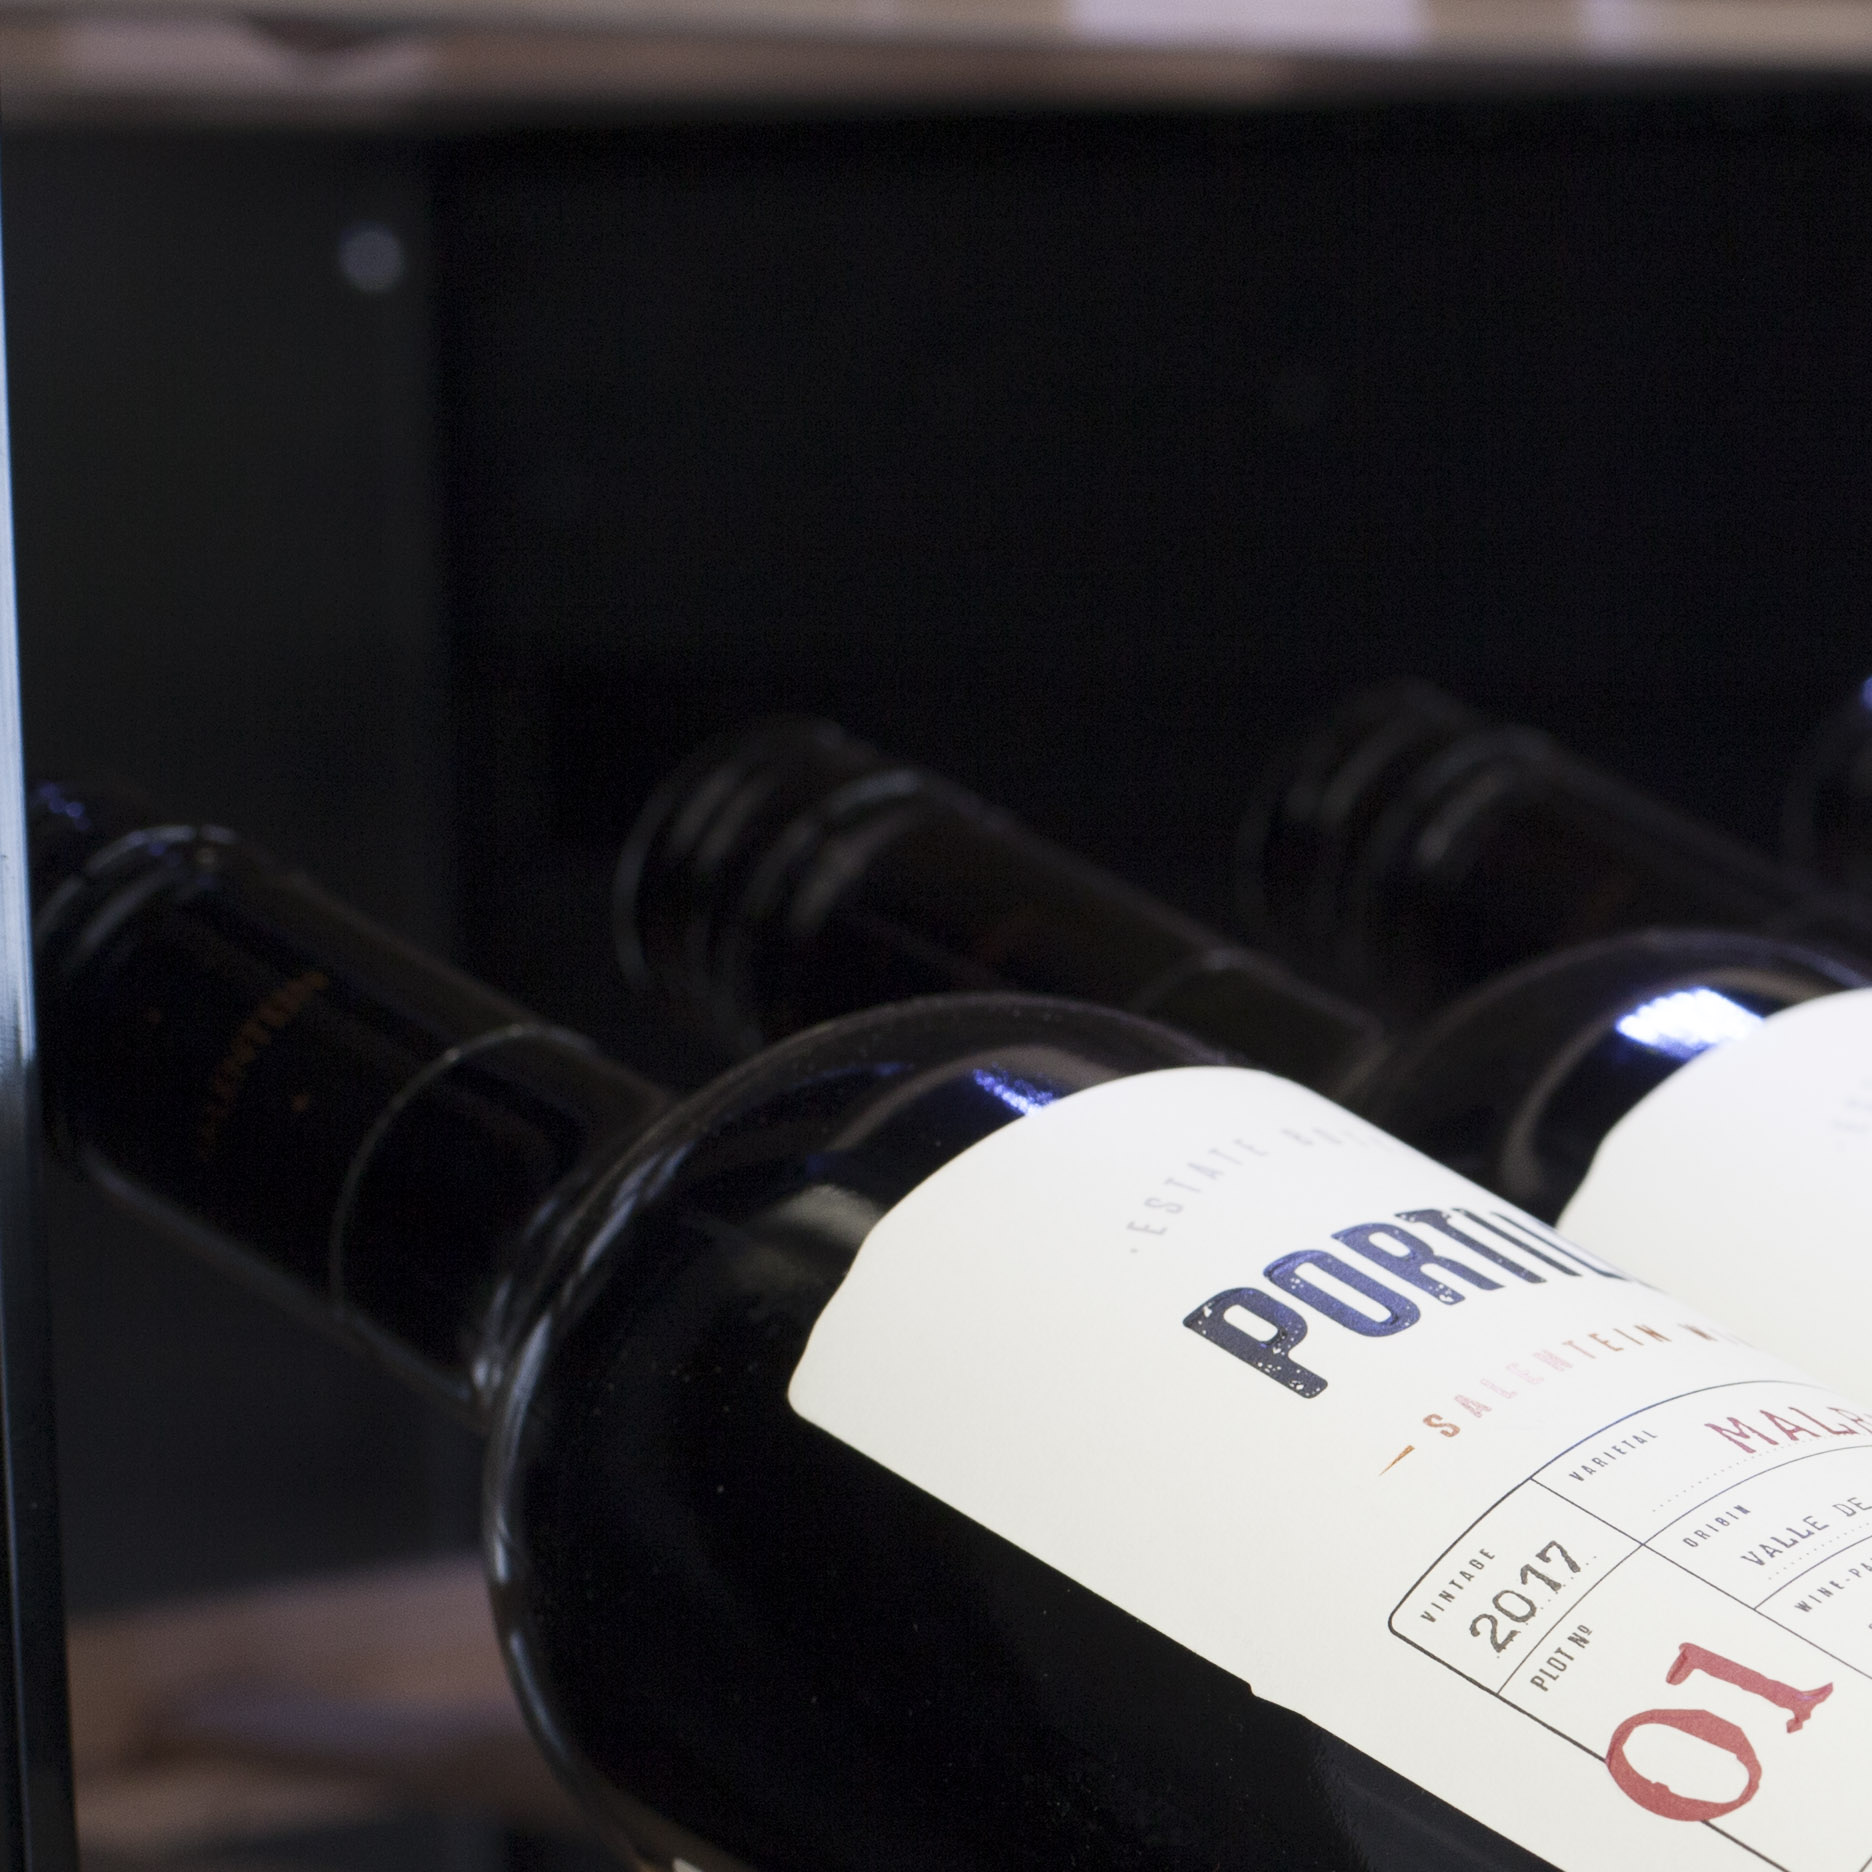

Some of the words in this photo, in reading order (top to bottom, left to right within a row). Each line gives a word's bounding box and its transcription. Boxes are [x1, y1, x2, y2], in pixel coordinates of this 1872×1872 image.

[1568, 1429, 1660, 1483] VARIETAL
[1681, 1504, 1752, 1548] ORIGIN
[1740, 1515, 1830, 1567] VALLE
[1420, 1548, 1496, 1623] VINTAGE
[1468, 1540, 1582, 1654] 2017
[1529, 1646, 1575, 1693] PLOT
[1605, 1641, 1835, 1823] 01
